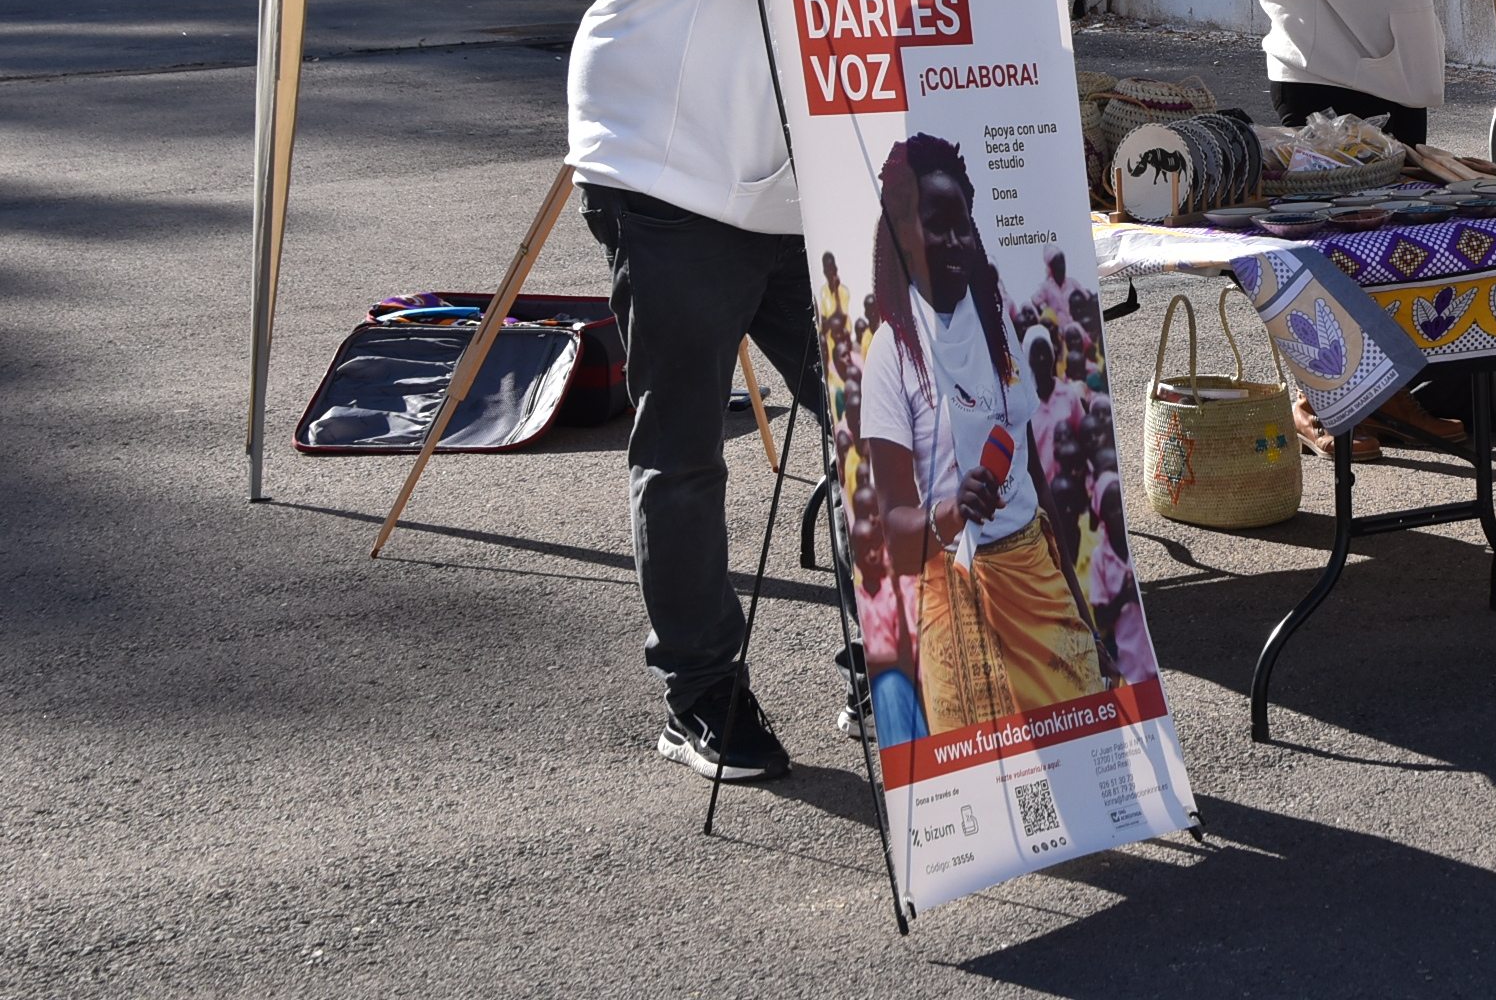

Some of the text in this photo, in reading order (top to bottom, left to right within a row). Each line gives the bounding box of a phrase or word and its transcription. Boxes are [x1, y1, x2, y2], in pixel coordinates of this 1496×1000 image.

[809, 53, 897, 102] VOZ
[919, 63, 1040, 97] ¡COLABORA!
[984, 123, 1057, 140] Apoya con una
[985, 139, 1025, 154] beca de
[988, 155, 1025, 170] estudio
[992, 187, 1018, 200] Dona
[995, 214, 1025, 228] Hazte
[998, 229, 1057, 247] voluntario/a
[934, 702, 1117, 764] www.fundacionkirira.es
[1013, 765, 1047, 779] voluntario/a
[916, 796, 930, 806] Dona
[934, 790, 951, 802] través
[952, 787, 960, 797] de
[924, 824, 956, 842] bizum
[926, 852, 975, 875] Código: 33556
